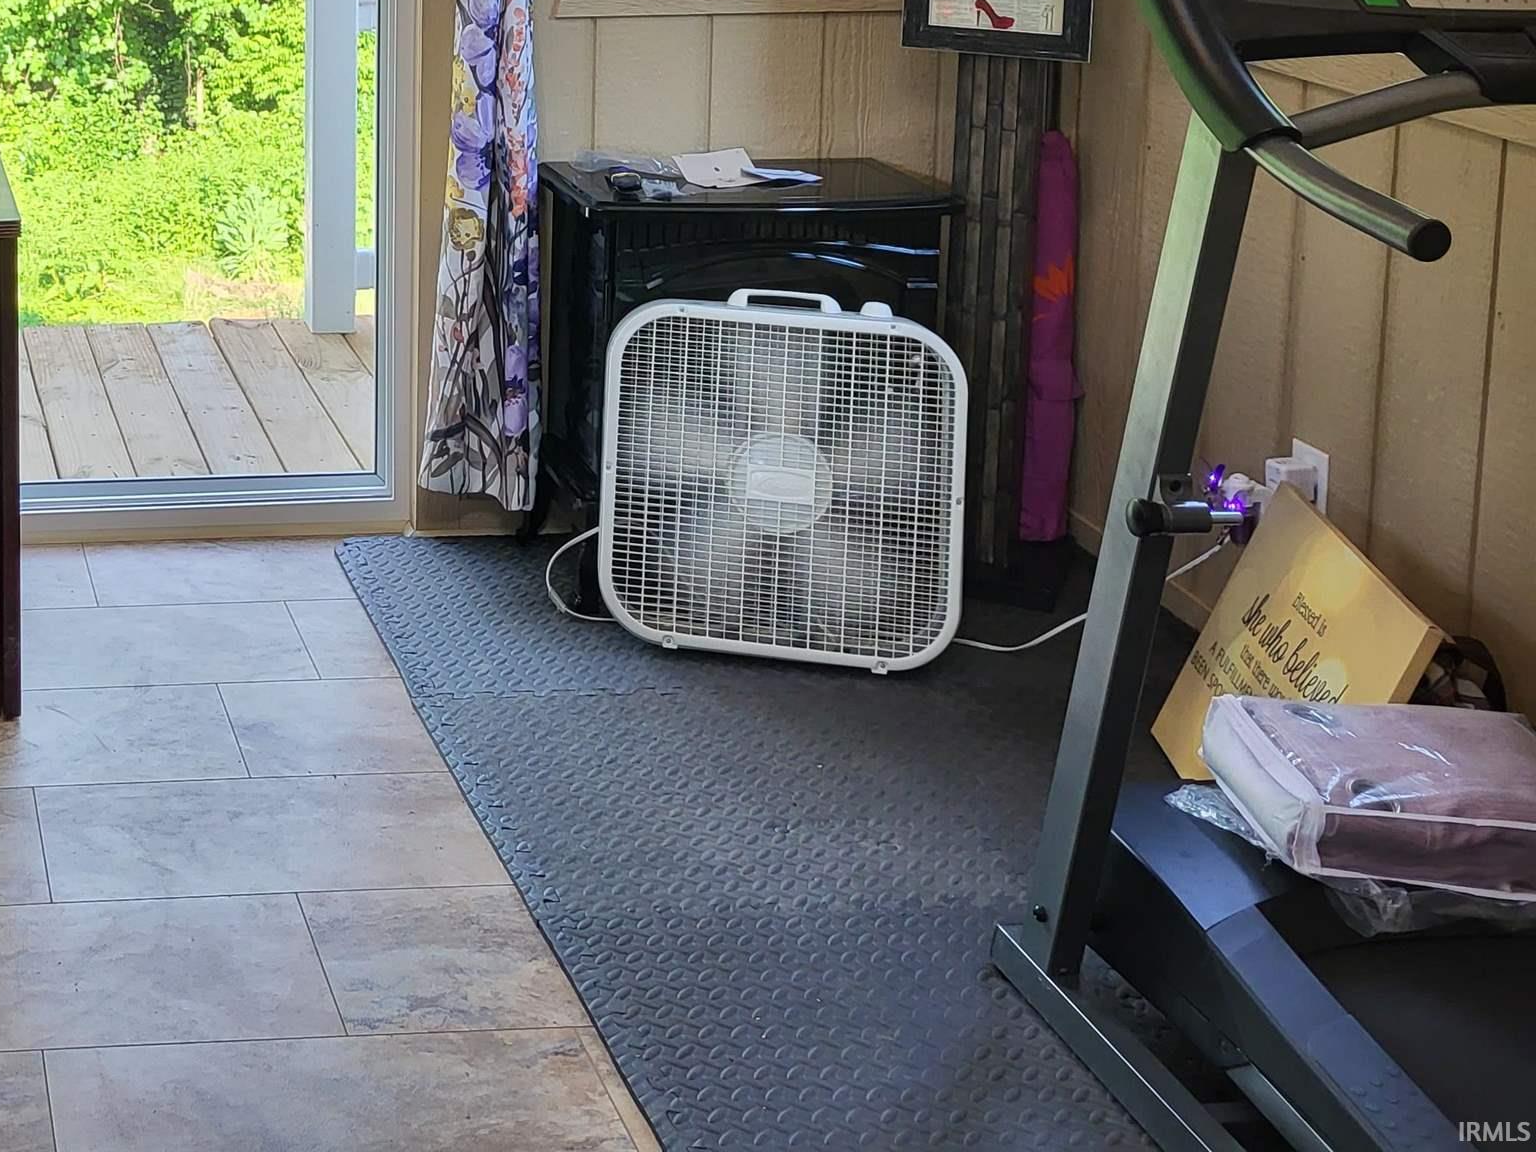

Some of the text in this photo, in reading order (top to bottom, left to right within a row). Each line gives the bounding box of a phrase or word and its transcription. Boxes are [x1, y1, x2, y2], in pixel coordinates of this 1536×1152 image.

[1291, 592, 1328, 637] Blessed is
[1191, 650, 1210, 680] BEEN
[1209, 641, 1218, 656] A
[1240, 644, 1271, 689] that there
[1258, 619, 1292, 664] who
[1282, 637, 1349, 704] believed
